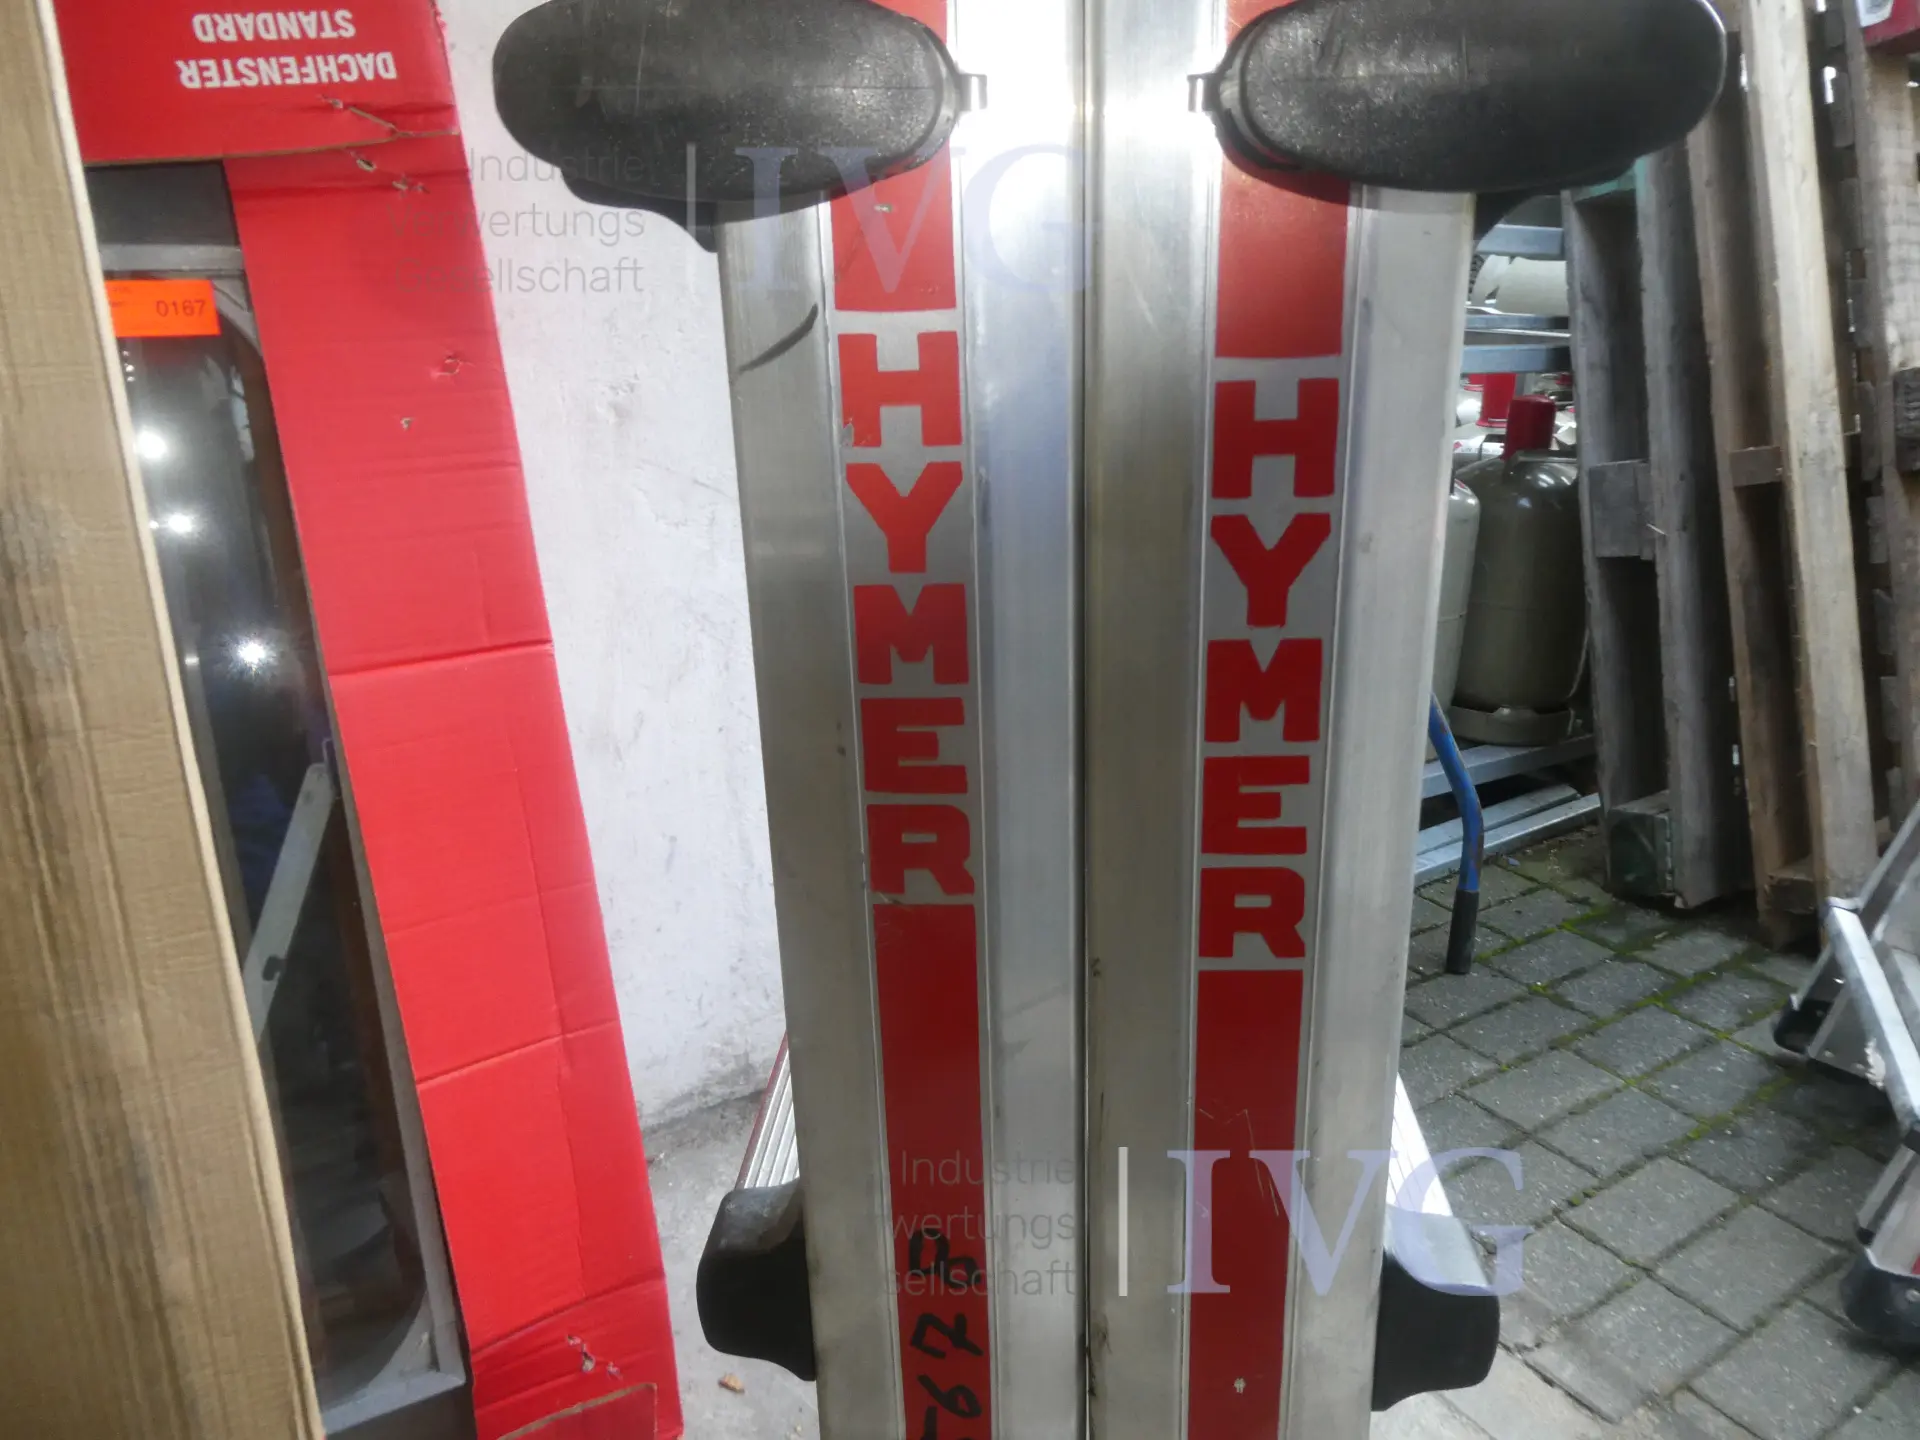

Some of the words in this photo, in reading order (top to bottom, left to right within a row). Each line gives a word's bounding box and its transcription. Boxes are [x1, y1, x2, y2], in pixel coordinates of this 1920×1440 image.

[193, 9, 356, 42] STANDARD
[175, 52, 397, 88] DACHFENSTER
[156, 299, 206, 317] 0167
[838, 331, 975, 895] HYMER
[1198, 378, 1339, 958] HYMER
